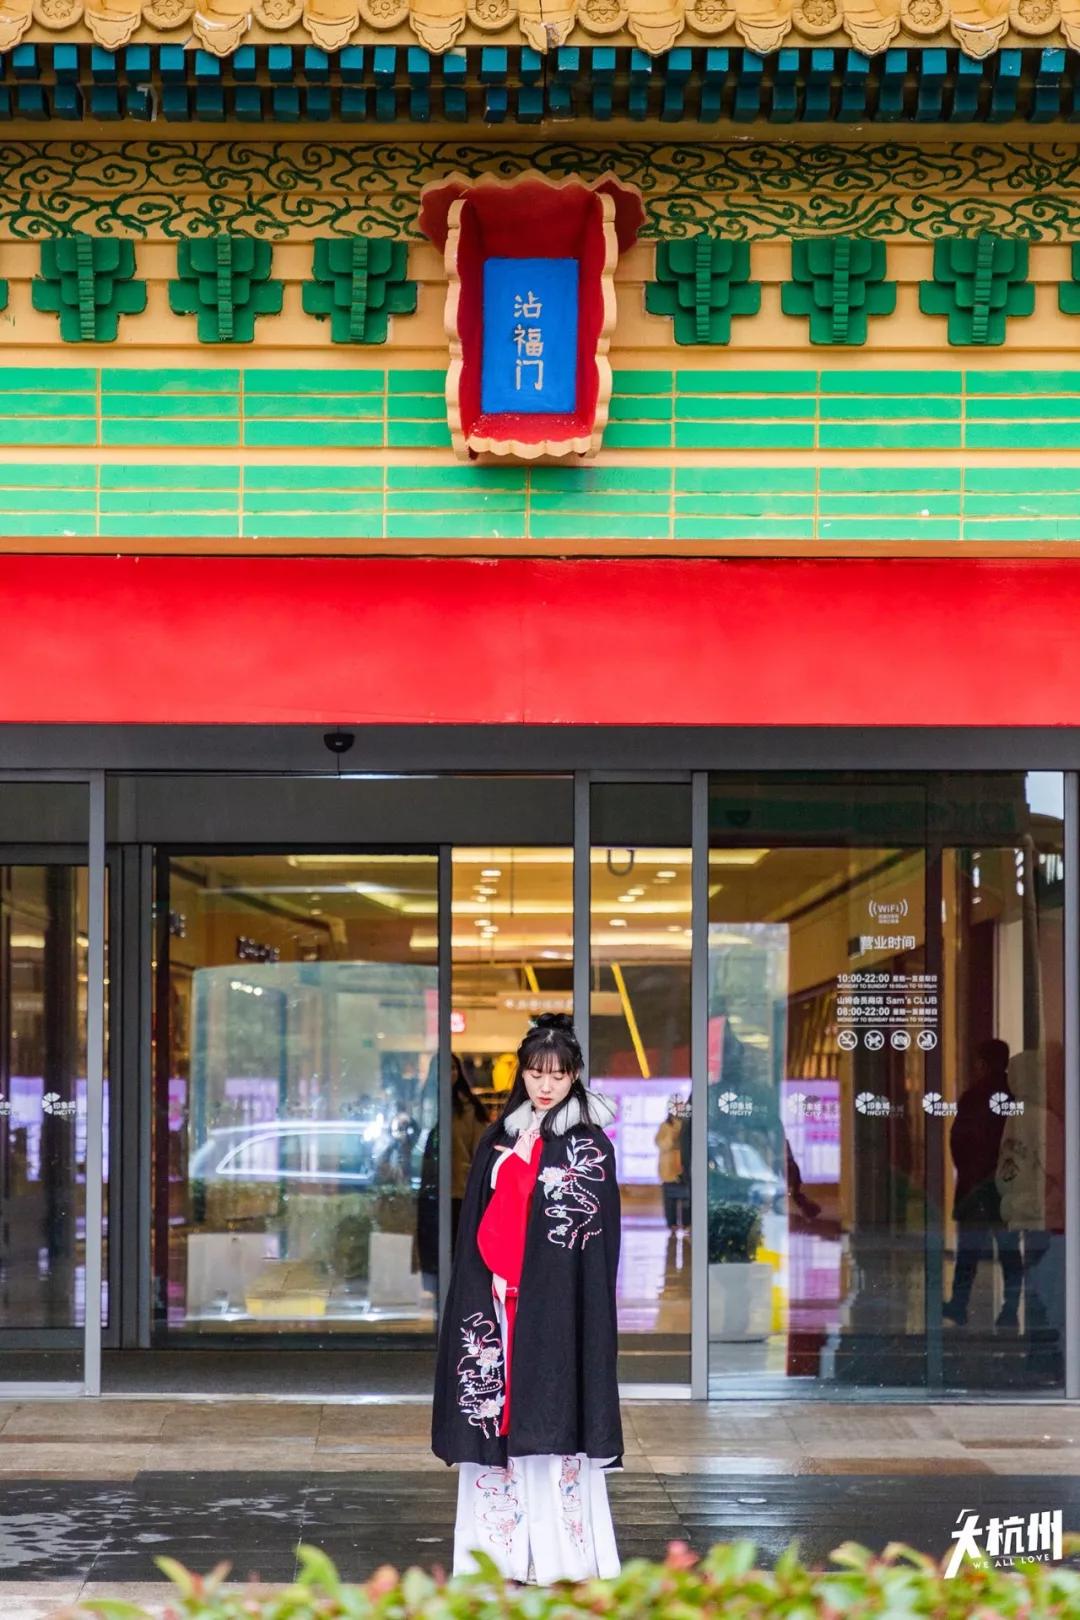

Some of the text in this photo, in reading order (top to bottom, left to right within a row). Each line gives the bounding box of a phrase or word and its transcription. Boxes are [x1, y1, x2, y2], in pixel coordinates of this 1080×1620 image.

[513, 290, 544, 391] 沾福门
[860, 936, 915, 950] 营业时间
[837, 973, 890, 983] 10:00-22:00
[886, 996, 912, 1005] Sam's
[913, 996, 938, 1005] CLUB
[837, 1007, 890, 1016] 08:00-22:00
